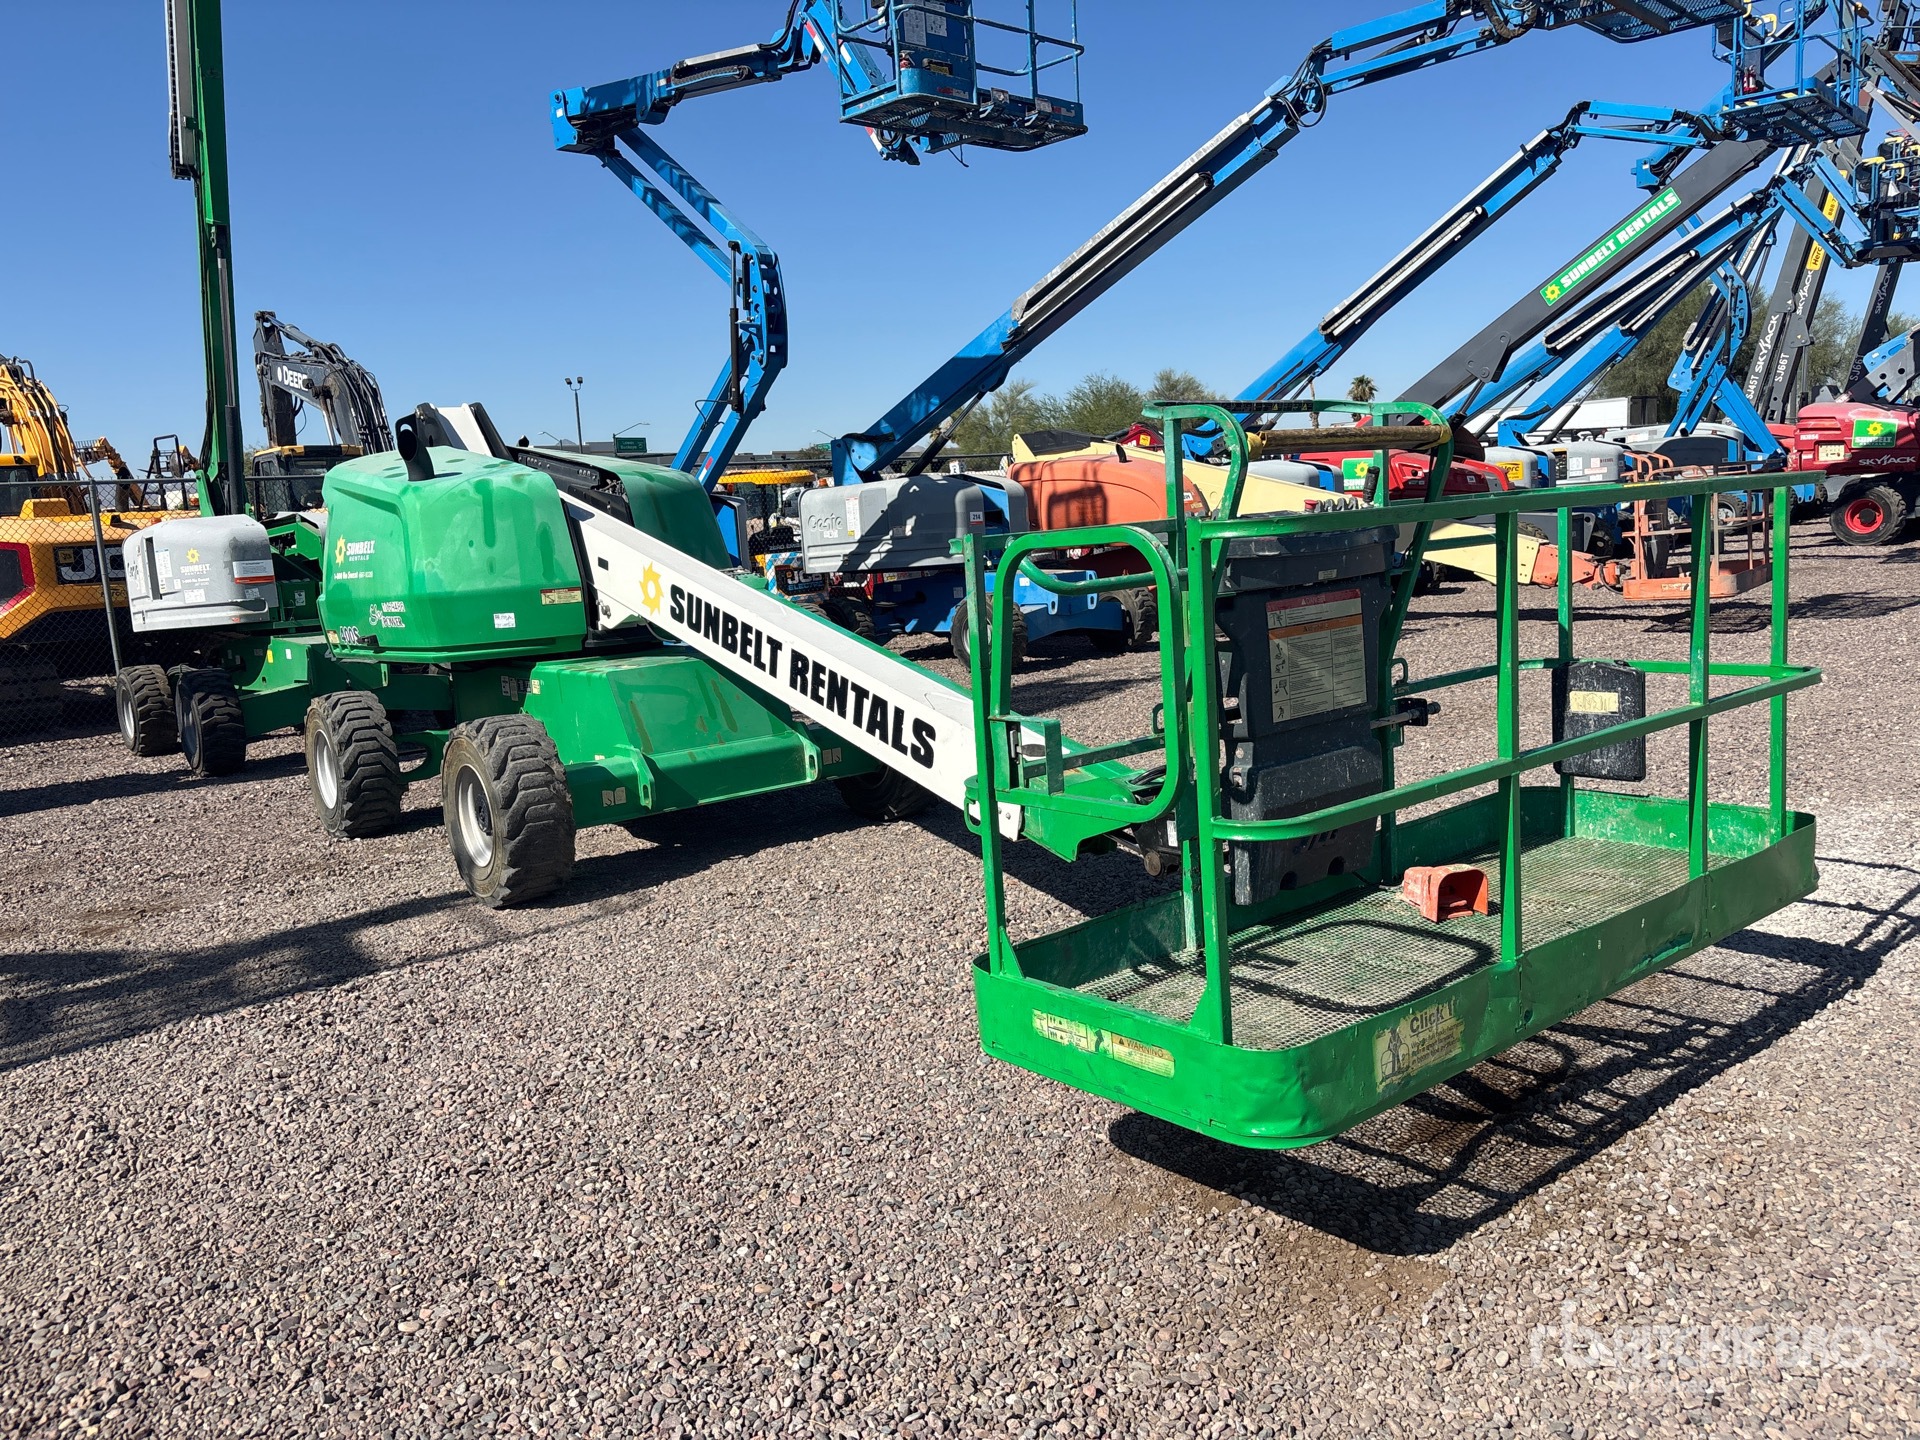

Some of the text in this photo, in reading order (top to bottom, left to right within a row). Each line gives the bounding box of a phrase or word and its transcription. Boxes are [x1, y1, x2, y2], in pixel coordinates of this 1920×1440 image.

[1560, 192, 1678, 289] SUNBELT RENTALS
[1813, 247, 1823, 265] Herc
[1875, 270, 1893, 314] SKYJACK
[1755, 314, 1780, 373] SKYJACK
[1775, 352, 1790, 382] SJ66T
[1746, 374, 1760, 399] SJ45T
[1858, 454, 1917, 466] SKYJACK
[346, 540, 376, 556] SUNBELT
[180, 563, 211, 573] SUNBELT
[787, 570, 823, 585] JCB
[670, 584, 937, 769] SUNBELT RENTALS
[1410, 1004, 1444, 1034] Click
[1127, 1038, 1164, 1058] WARNING
